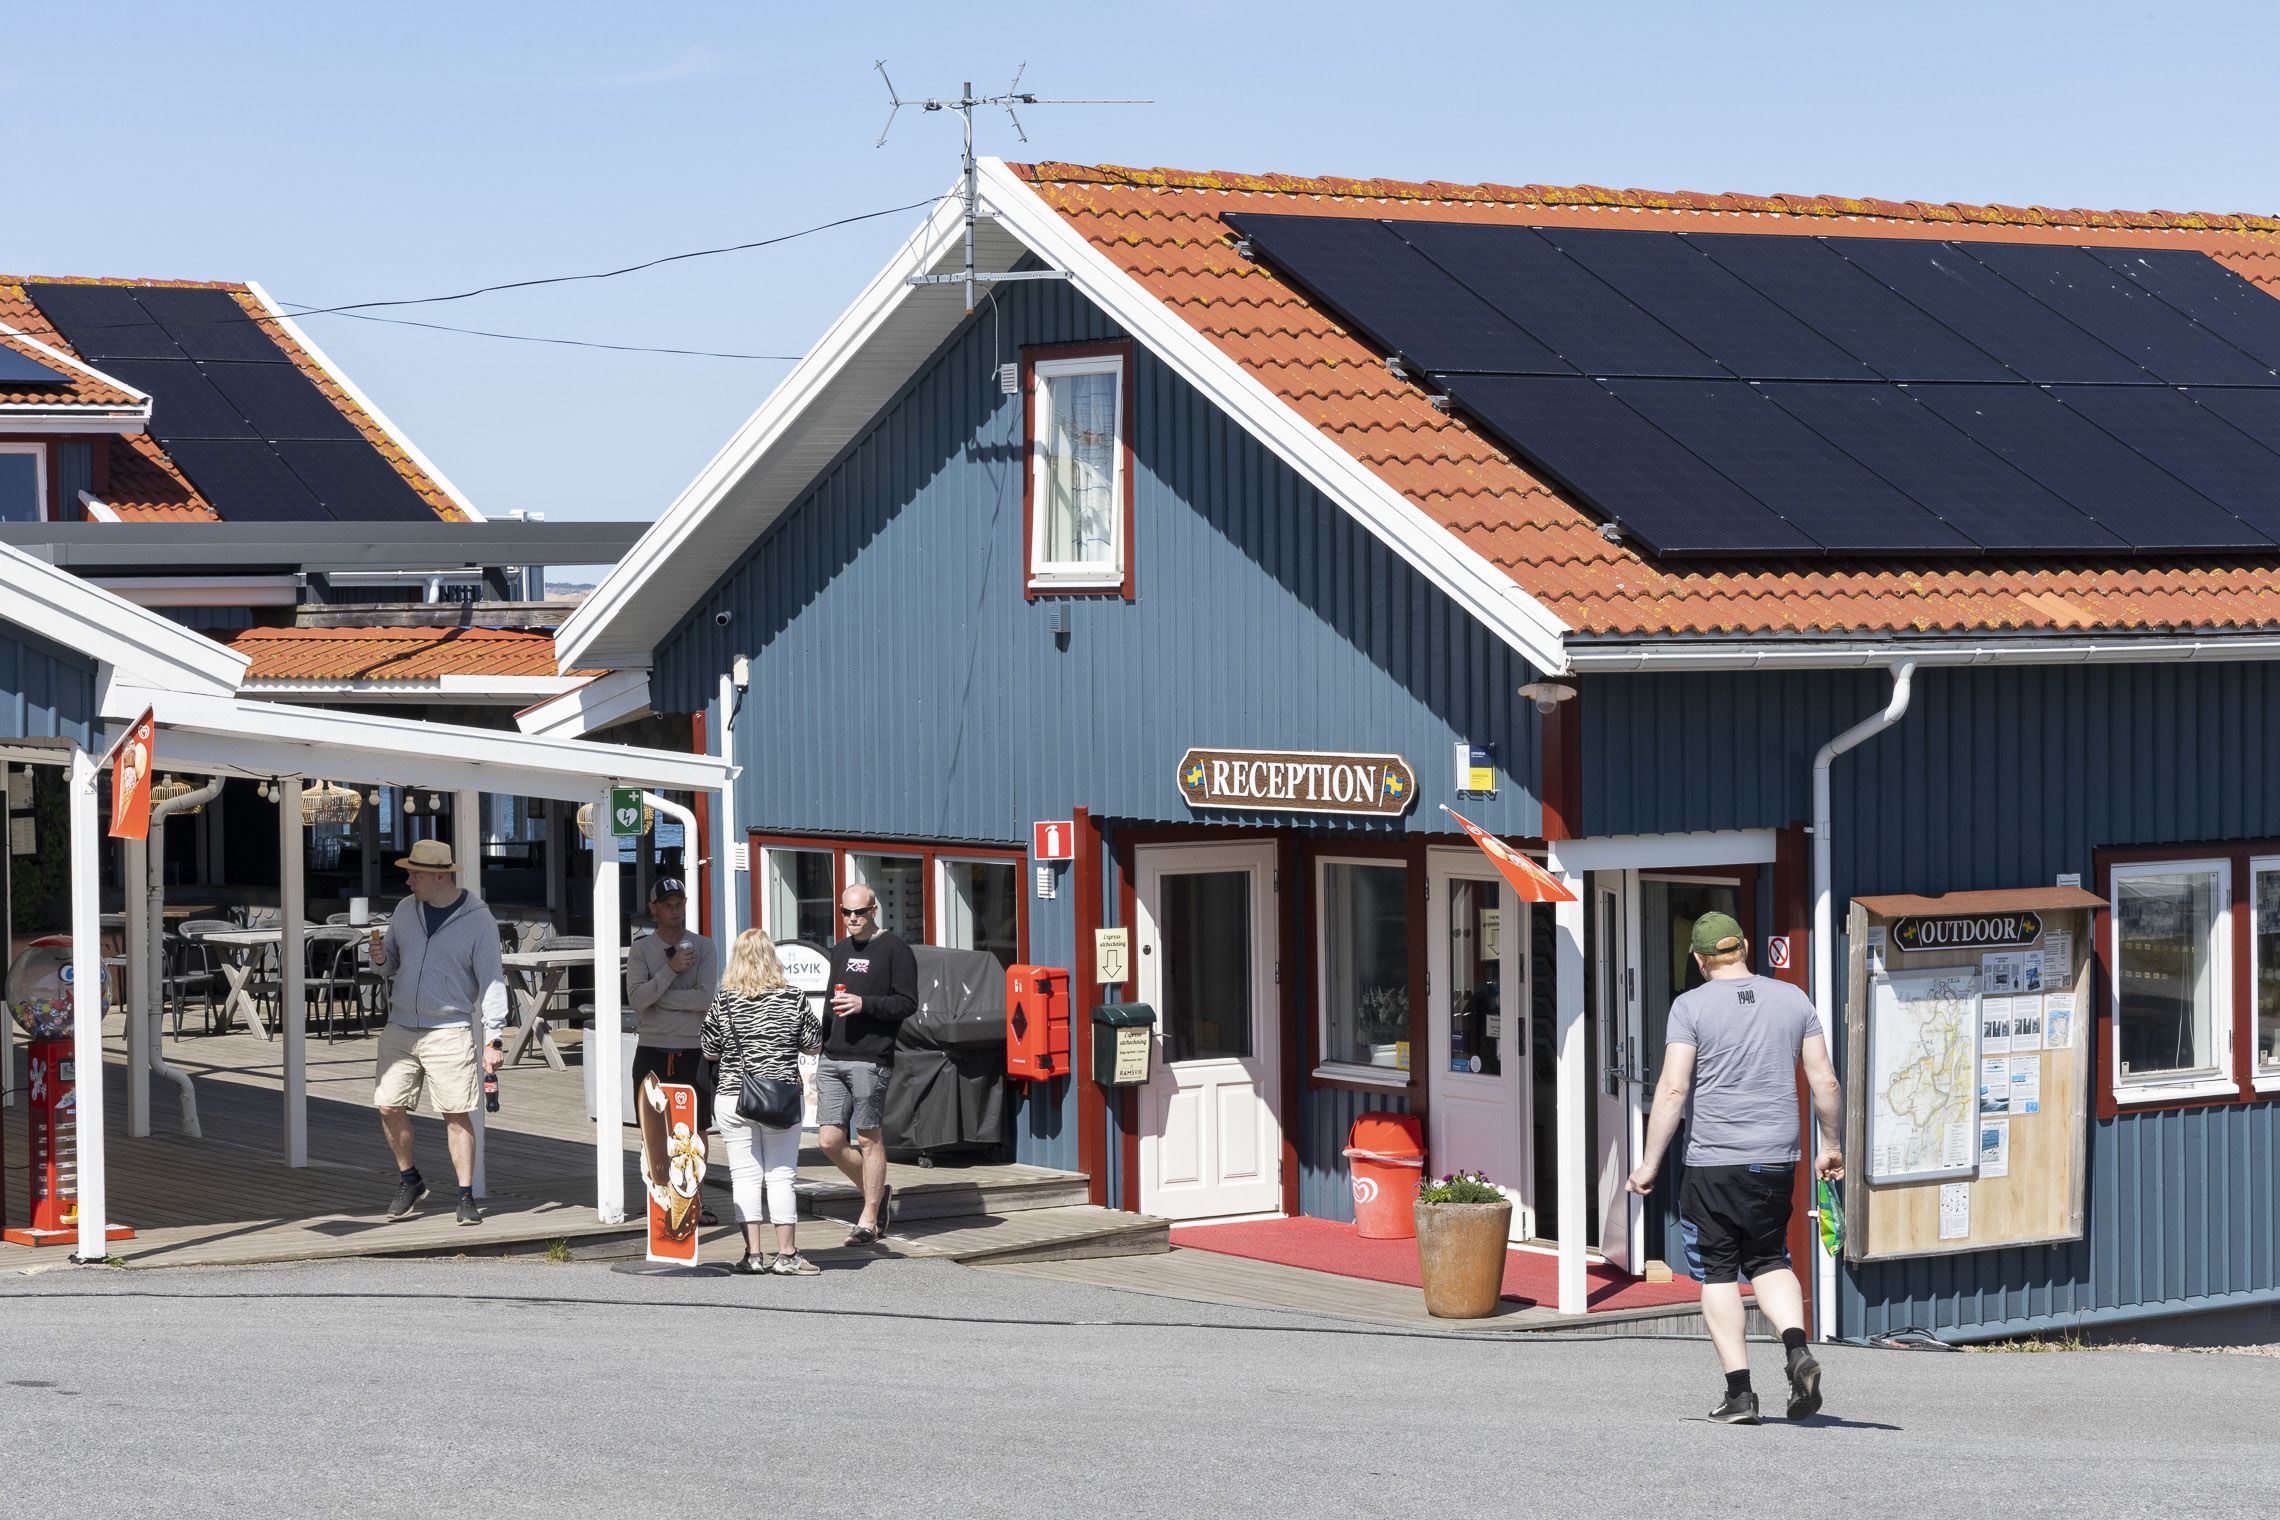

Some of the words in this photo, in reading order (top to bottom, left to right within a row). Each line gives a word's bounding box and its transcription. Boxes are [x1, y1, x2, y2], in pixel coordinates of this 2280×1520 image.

[1211, 759, 1377, 803] RECEPTION
[1921, 917, 2017, 943] OUTDOOR
[783, 963, 821, 974] MSVIK
[1737, 990, 1755, 1004] 1940
